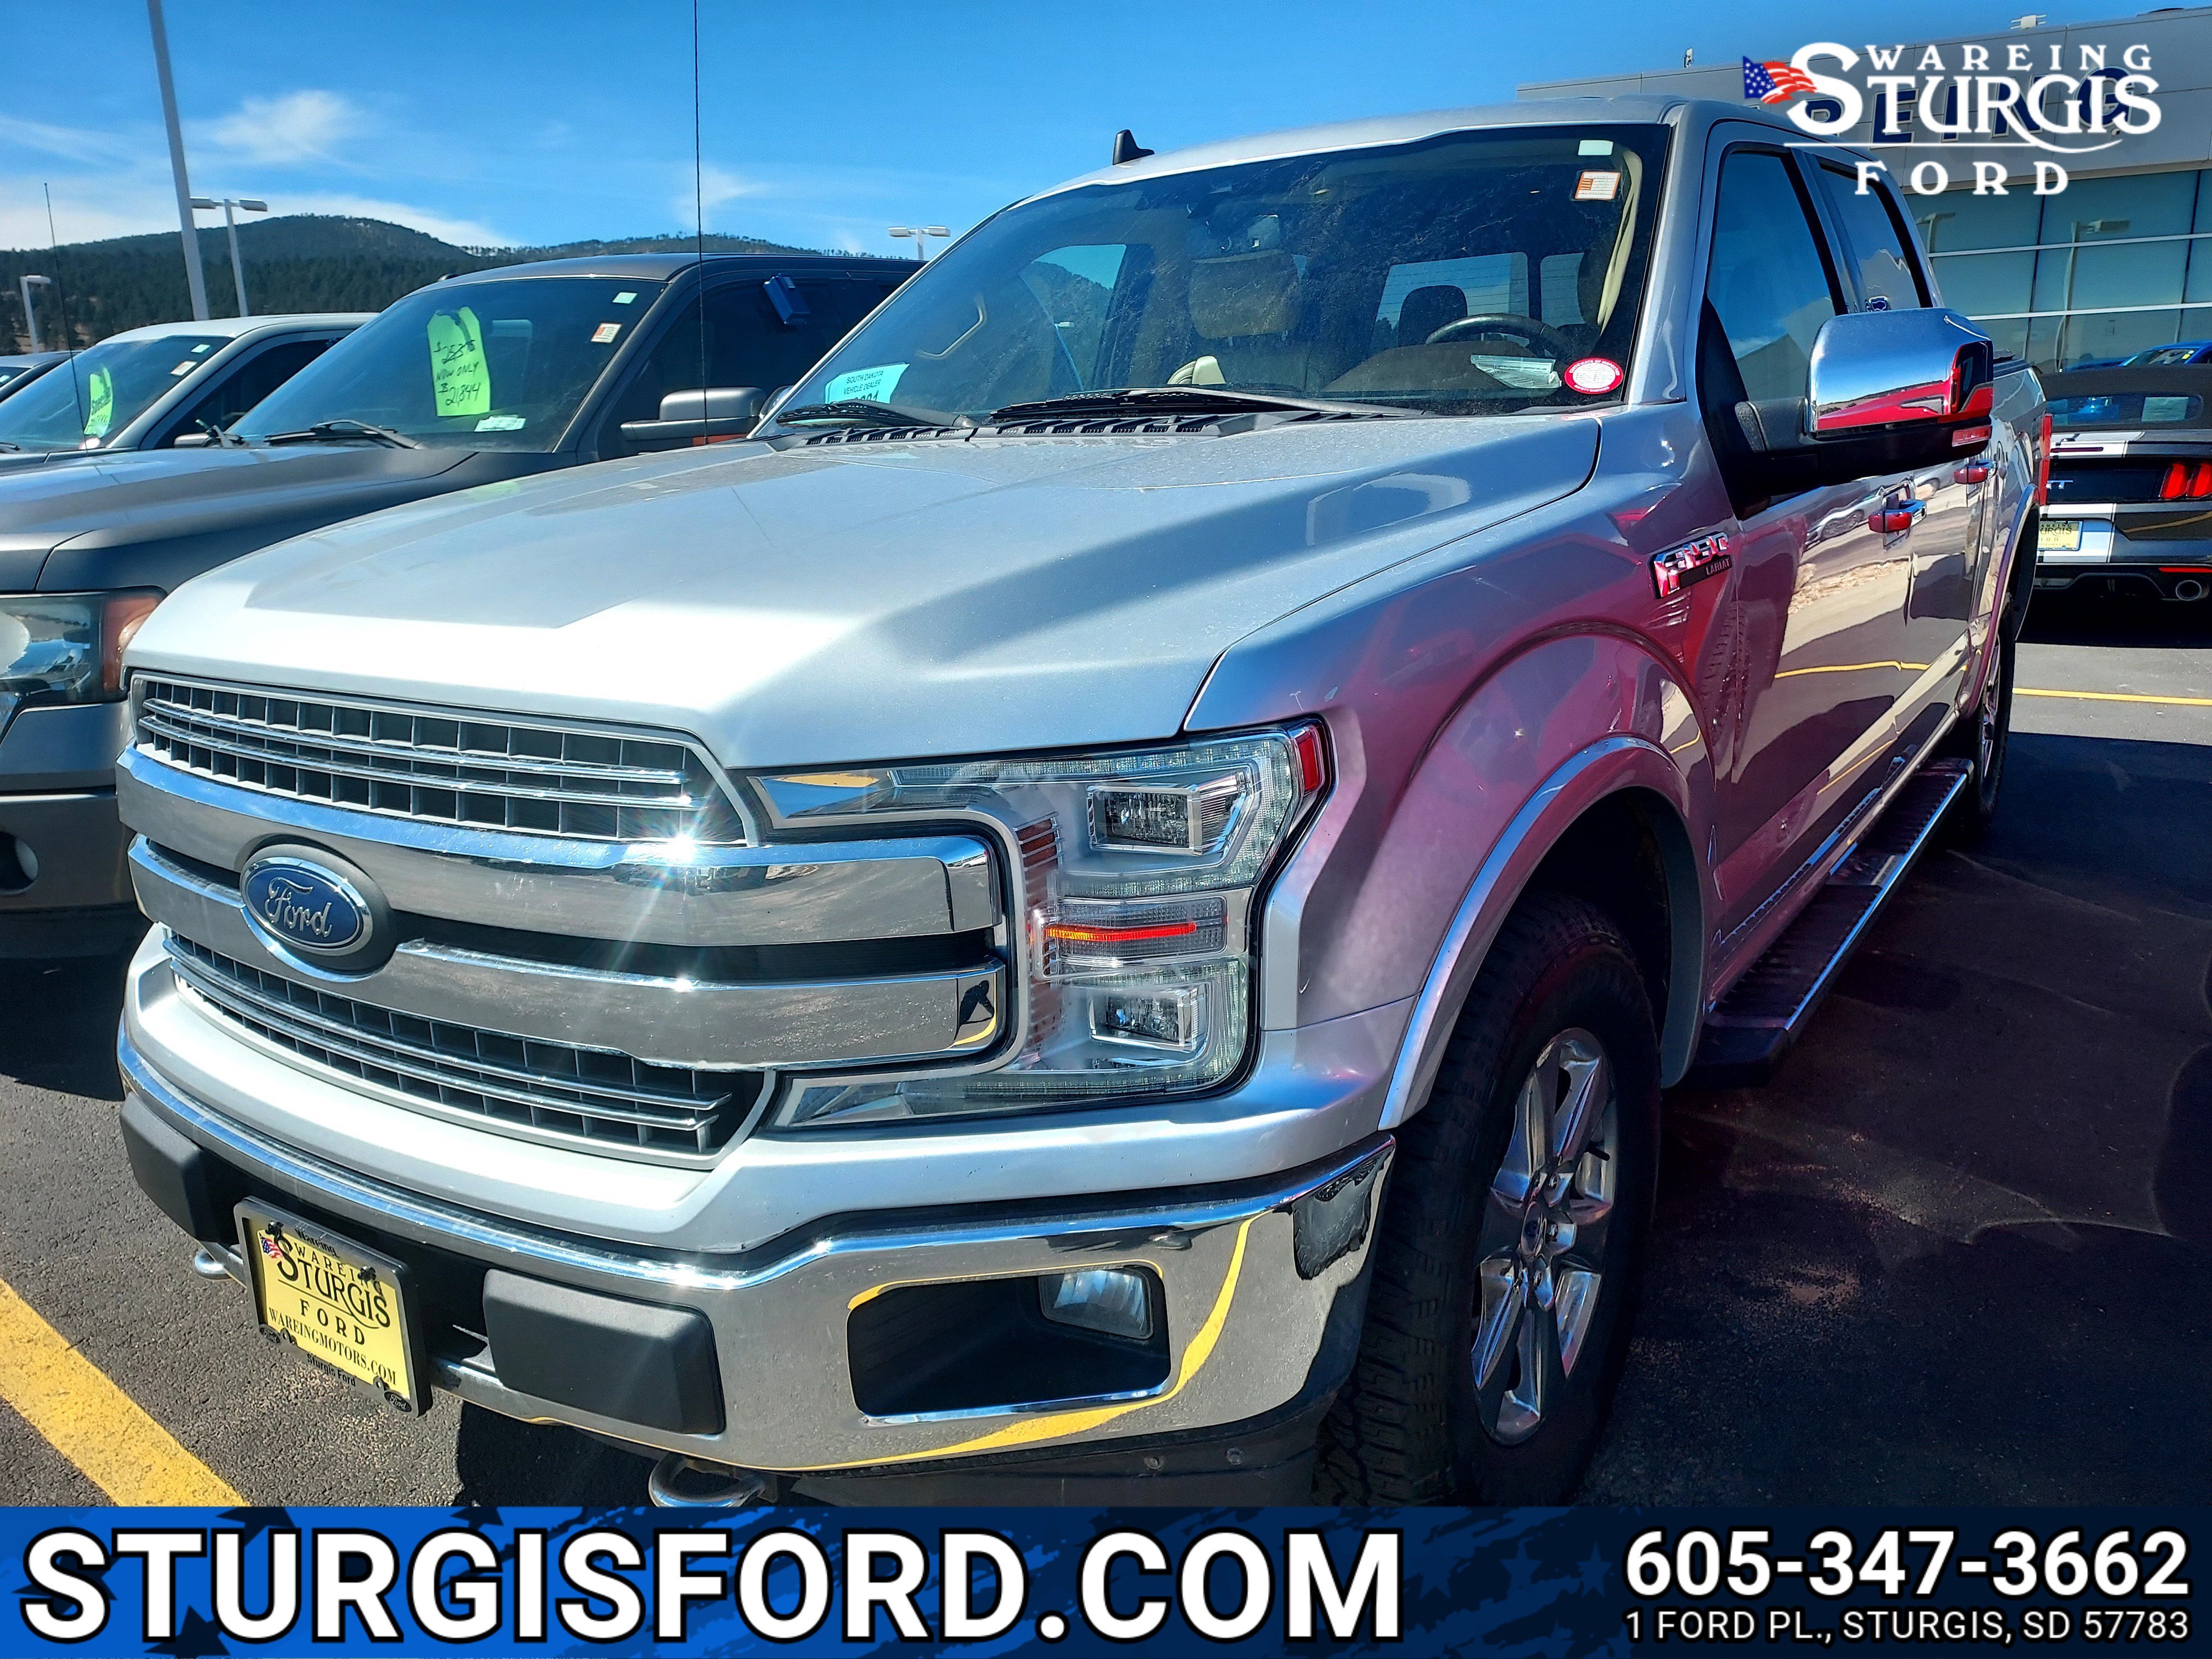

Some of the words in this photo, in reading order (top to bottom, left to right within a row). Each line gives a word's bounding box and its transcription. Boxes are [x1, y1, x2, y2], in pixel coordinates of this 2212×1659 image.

[843, 384, 864, 395] VEHICLE
[846, 374, 864, 384] SOUTH
[864, 371, 884, 381] DAKOTA
[1705, 557, 1730, 575] LARIAT
[264, 877, 333, 938] Ford
[276, 1237, 390, 1329] STURGIS
[294, 1242, 383, 1296] WAREIG
[299, 1298, 366, 1345] FORD
[268, 1306, 397, 1386] WAREINGMOTORS.COM
[307, 1353, 336, 1378] Sturgis
[337, 1369, 356, 1387] Ford
[389, 1393, 407, 1410] Ford
